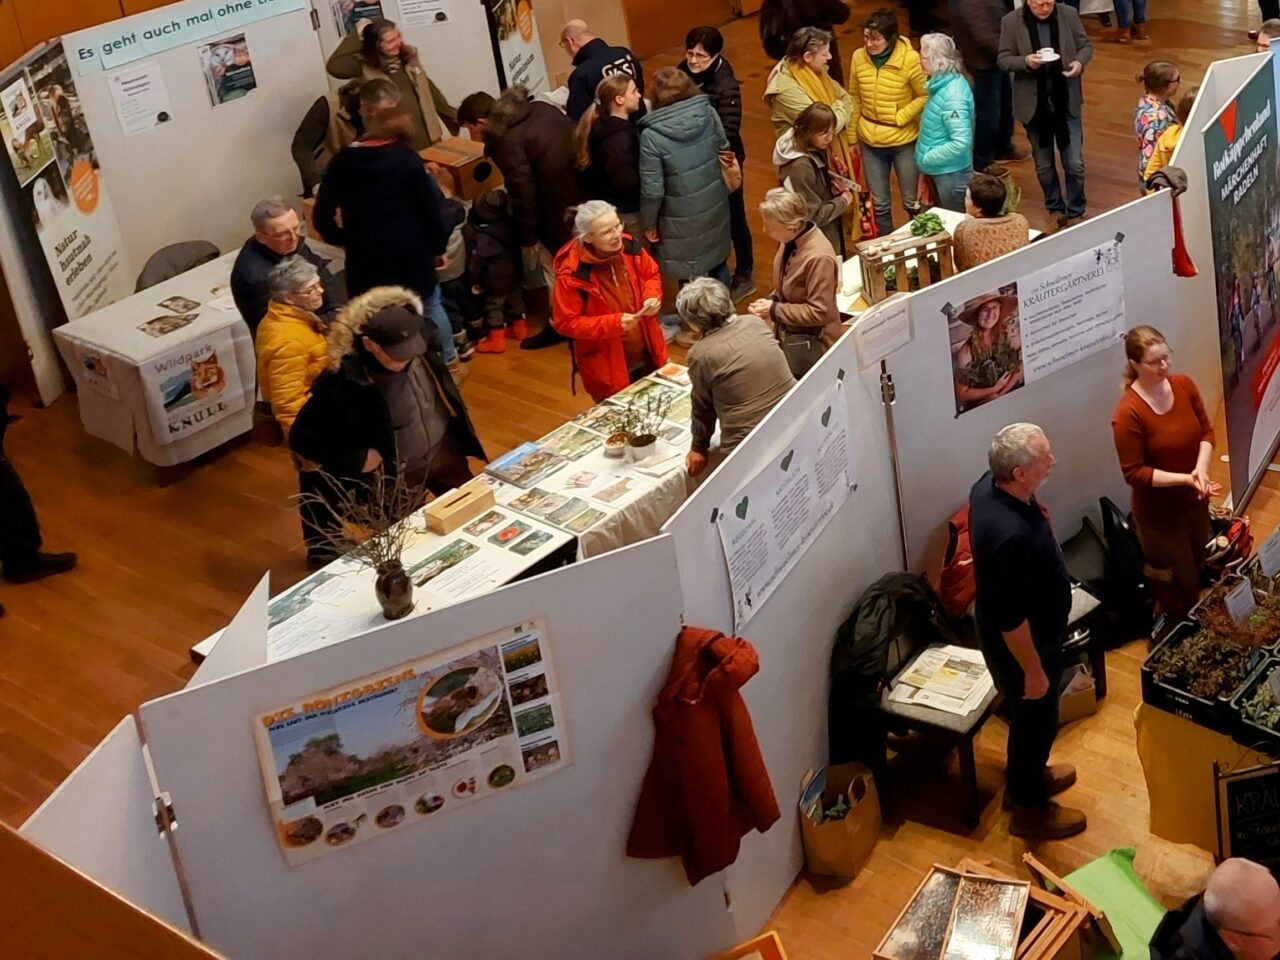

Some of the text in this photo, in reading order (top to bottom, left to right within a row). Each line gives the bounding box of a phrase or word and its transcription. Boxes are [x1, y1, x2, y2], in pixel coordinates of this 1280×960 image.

[78, 47, 94, 61] Es
[102, 32, 137, 55] geht
[143, 21, 181, 40] auch
[186, 9, 213, 27] mal
[217, 0, 252, 18] ohne
[1213, 99, 1271, 181] Rotkäppchenland
[1221, 134, 1268, 201] MÄRCHENHAFT
[1234, 164, 1259, 205] RADELN
[53, 229, 79, 258] Natur
[59, 235, 92, 272] hautnah
[65, 253, 94, 287] erleben
[154, 343, 215, 375] Wildpark
